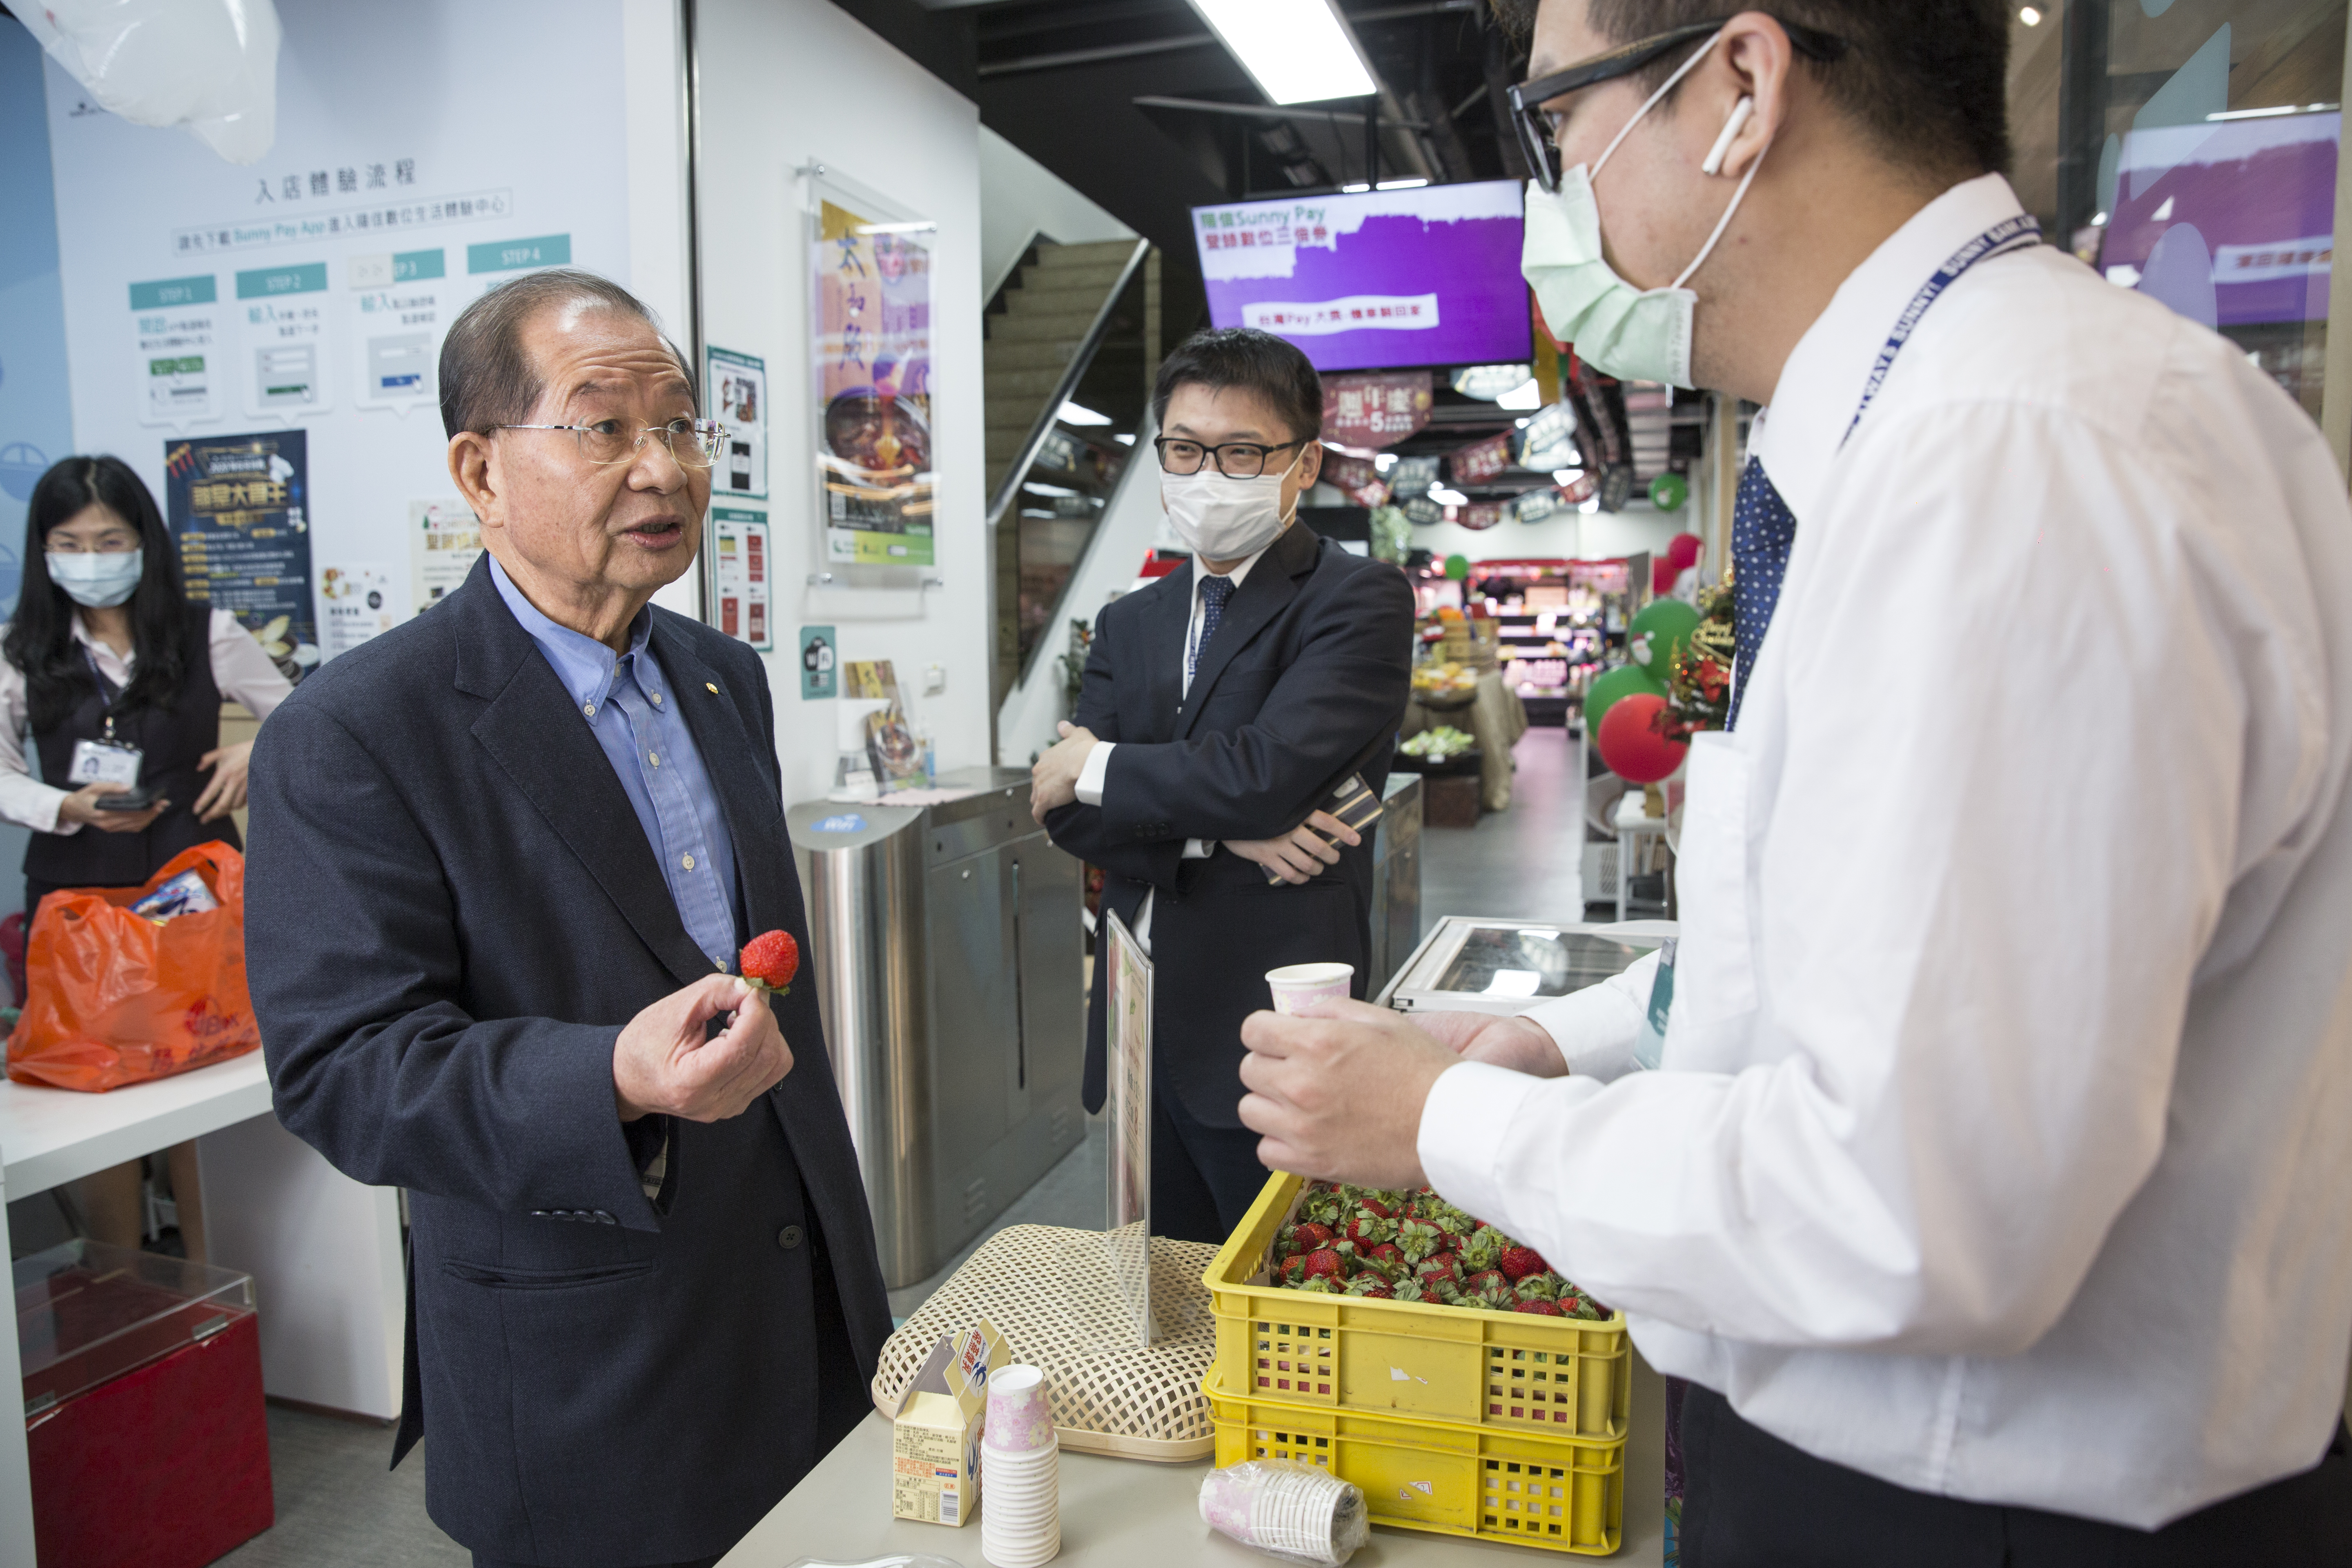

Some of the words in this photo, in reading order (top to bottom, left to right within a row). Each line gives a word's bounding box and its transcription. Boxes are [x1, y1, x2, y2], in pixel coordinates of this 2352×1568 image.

[256, 158, 416, 204] 入店體驗流程
[1295, 205, 1326, 225] Pay
[275, 222, 298, 242] Pay
[301, 219, 325, 239] App
[502, 249, 530, 265] STEP
[533, 249, 541, 261] 4
[1940, 235, 1995, 278] SUNNY
[410, 261, 417, 276] 3
[265, 275, 292, 292] STEP
[294, 274, 301, 290] 2
[159, 287, 183, 303] STEP
[1370, 411, 1384, 432] 5
[962, 1330, 982, 1376] 飛燕煉乳
